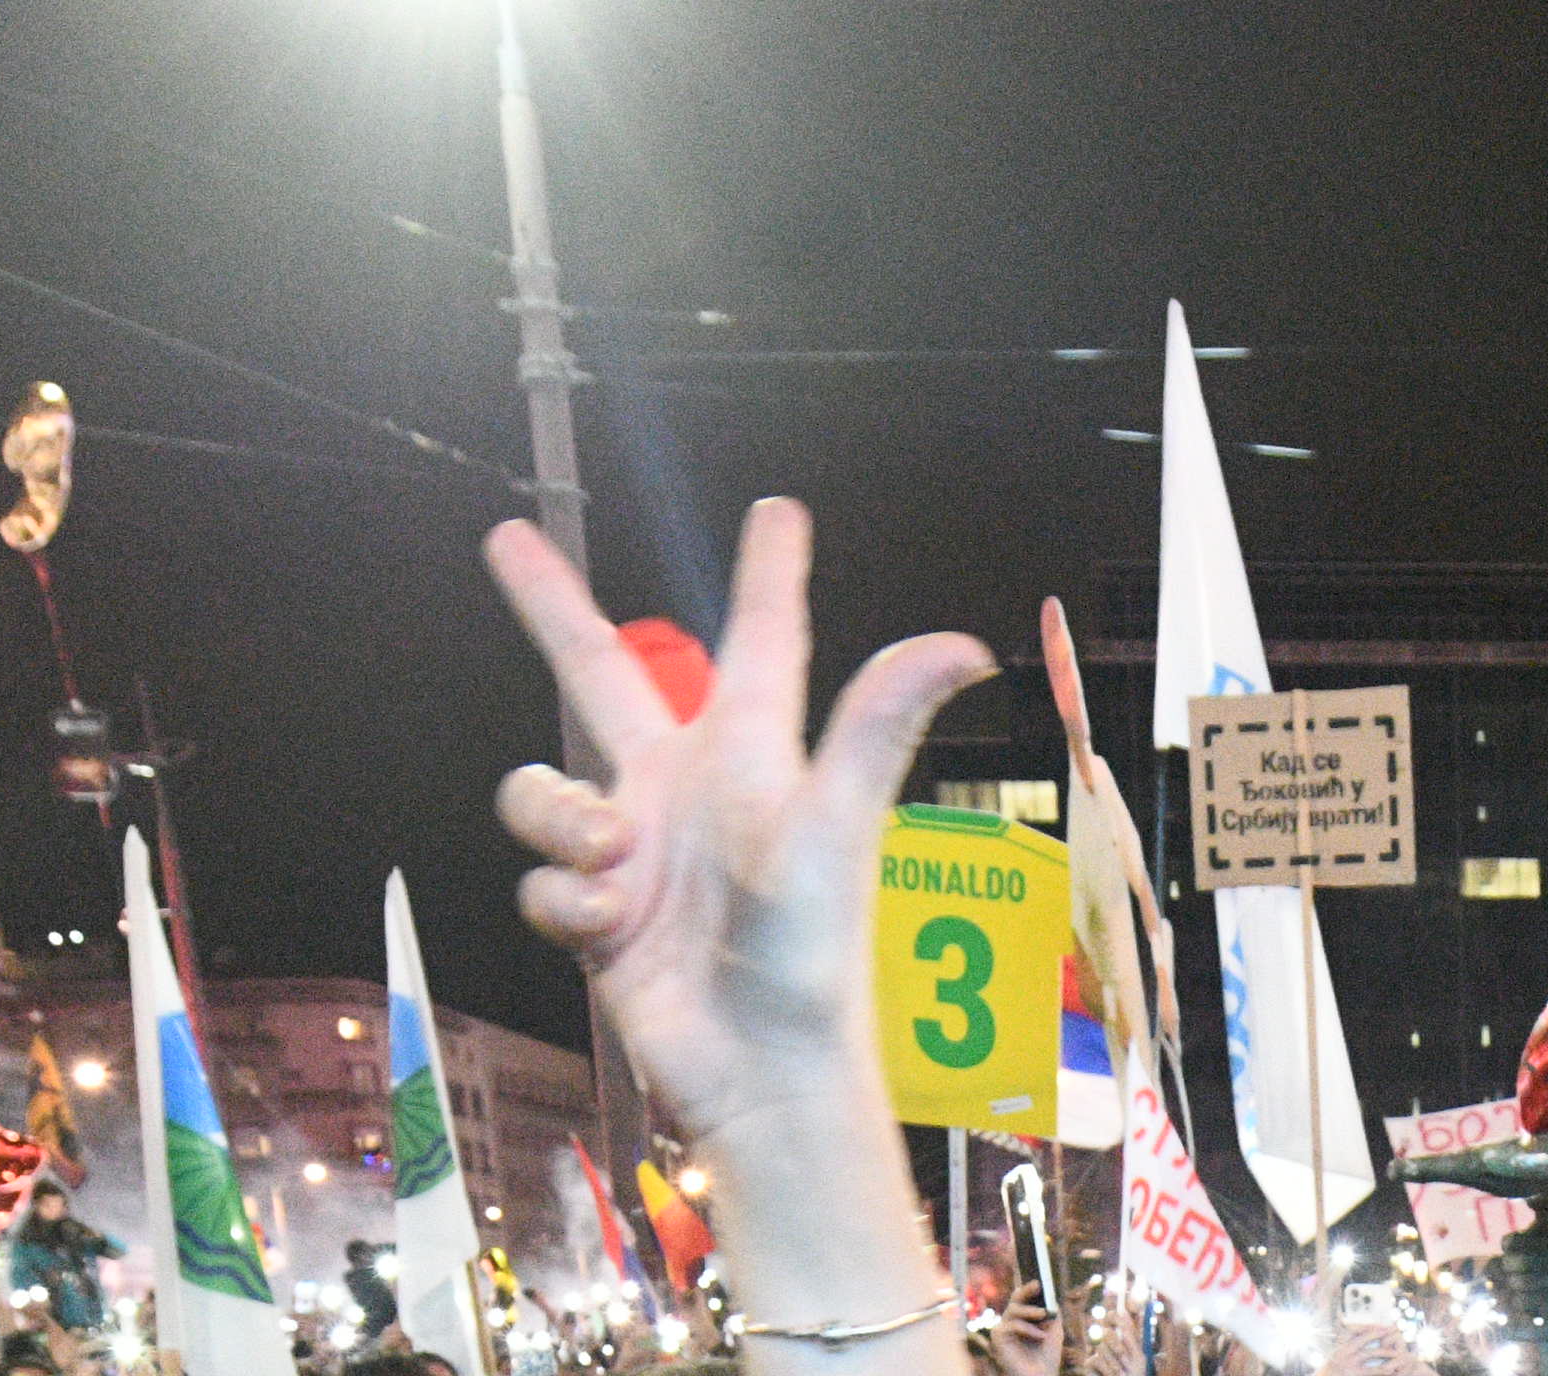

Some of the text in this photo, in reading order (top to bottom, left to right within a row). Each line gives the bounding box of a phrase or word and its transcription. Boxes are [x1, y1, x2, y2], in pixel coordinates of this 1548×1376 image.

[1261, 751, 1341, 777] Кад се
[1351, 778, 1365, 803] у
[880, 854, 1027, 903] RONALDO
[912, 914, 996, 1069] 3
